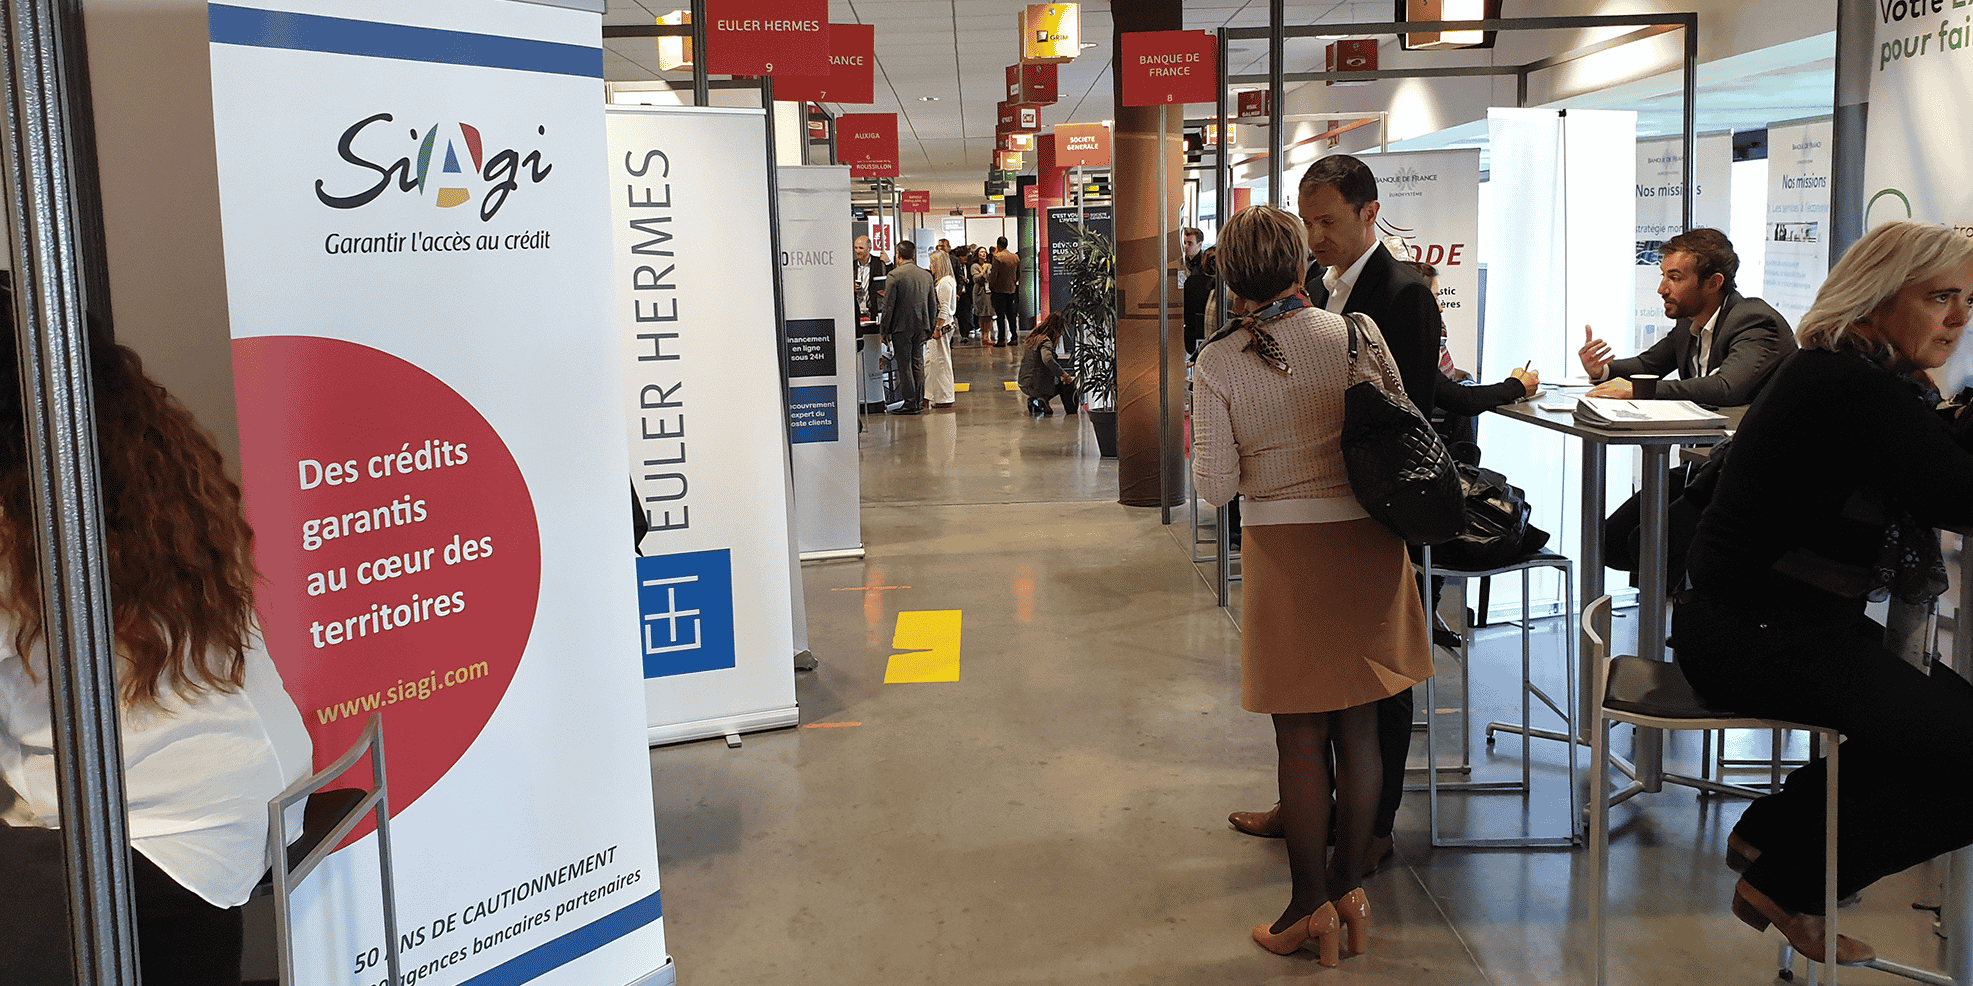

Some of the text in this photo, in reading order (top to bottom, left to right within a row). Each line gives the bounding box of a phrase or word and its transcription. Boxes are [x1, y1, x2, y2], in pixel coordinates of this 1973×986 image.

[1880, 0, 1943, 24] Votre
[717, 20, 820, 32] EULER HERMES
[1880, 14, 1973, 71] pour fai
[1139, 52, 1200, 65] BANQUE DE
[765, 62, 774, 73] 9
[1149, 66, 1191, 77] FRANCE
[820, 90, 827, 100] 7
[1166, 93, 1173, 102] 8
[854, 132, 881, 140] AUXIGA
[1375, 174, 1438, 183] BANQUE DE FRANCE
[1782, 172, 1827, 189] Nos missions
[1635, 182, 1702, 198] Nos missis
[324, 229, 551, 255] Garantir l'accès au crédit
[625, 149, 689, 532] EULER HERMES
[803, 344, 821, 353] ligne
[809, 353, 825, 361] 24H
[791, 411, 815, 419] expert
[298, 439, 469, 491] Des crédits
[301, 493, 428, 551] garantis
[306, 534, 494, 597] au cœur des
[309, 590, 466, 649] territoires
[316, 659, 489, 725] www.siagi.com
[353, 946, 379, 974] 50
[431, 912, 457, 940] DE
[462, 845, 618, 925] CAUTIONNEMENT
[472, 905, 551, 955] bancaires
[554, 868, 641, 921] partenaires
